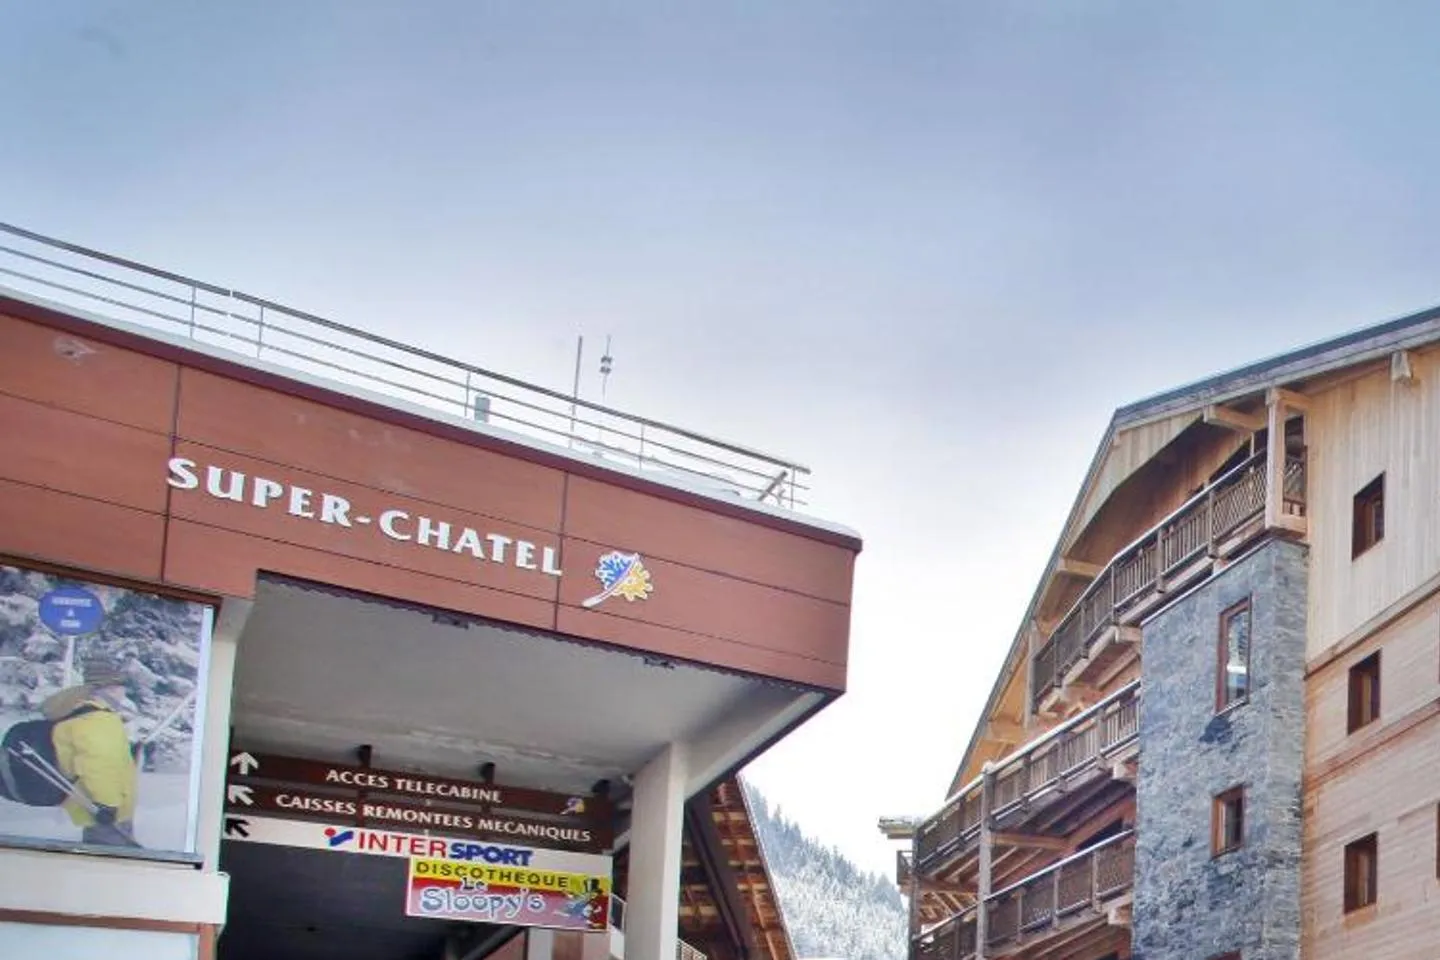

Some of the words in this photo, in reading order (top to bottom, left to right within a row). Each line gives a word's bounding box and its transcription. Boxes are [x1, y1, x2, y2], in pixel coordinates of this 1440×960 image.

[166, 457, 562, 576] SUPER-CHATEL
[326, 769, 389, 789] ACCES
[395, 777, 504, 804] TELECABINE
[275, 794, 357, 815] CAISSES
[362, 804, 473, 829] REMONTEES
[416, 861, 569, 889] DISCOTHEQUE
[462, 877, 488, 892] Le
[421, 886, 546, 919] Sloopy's
